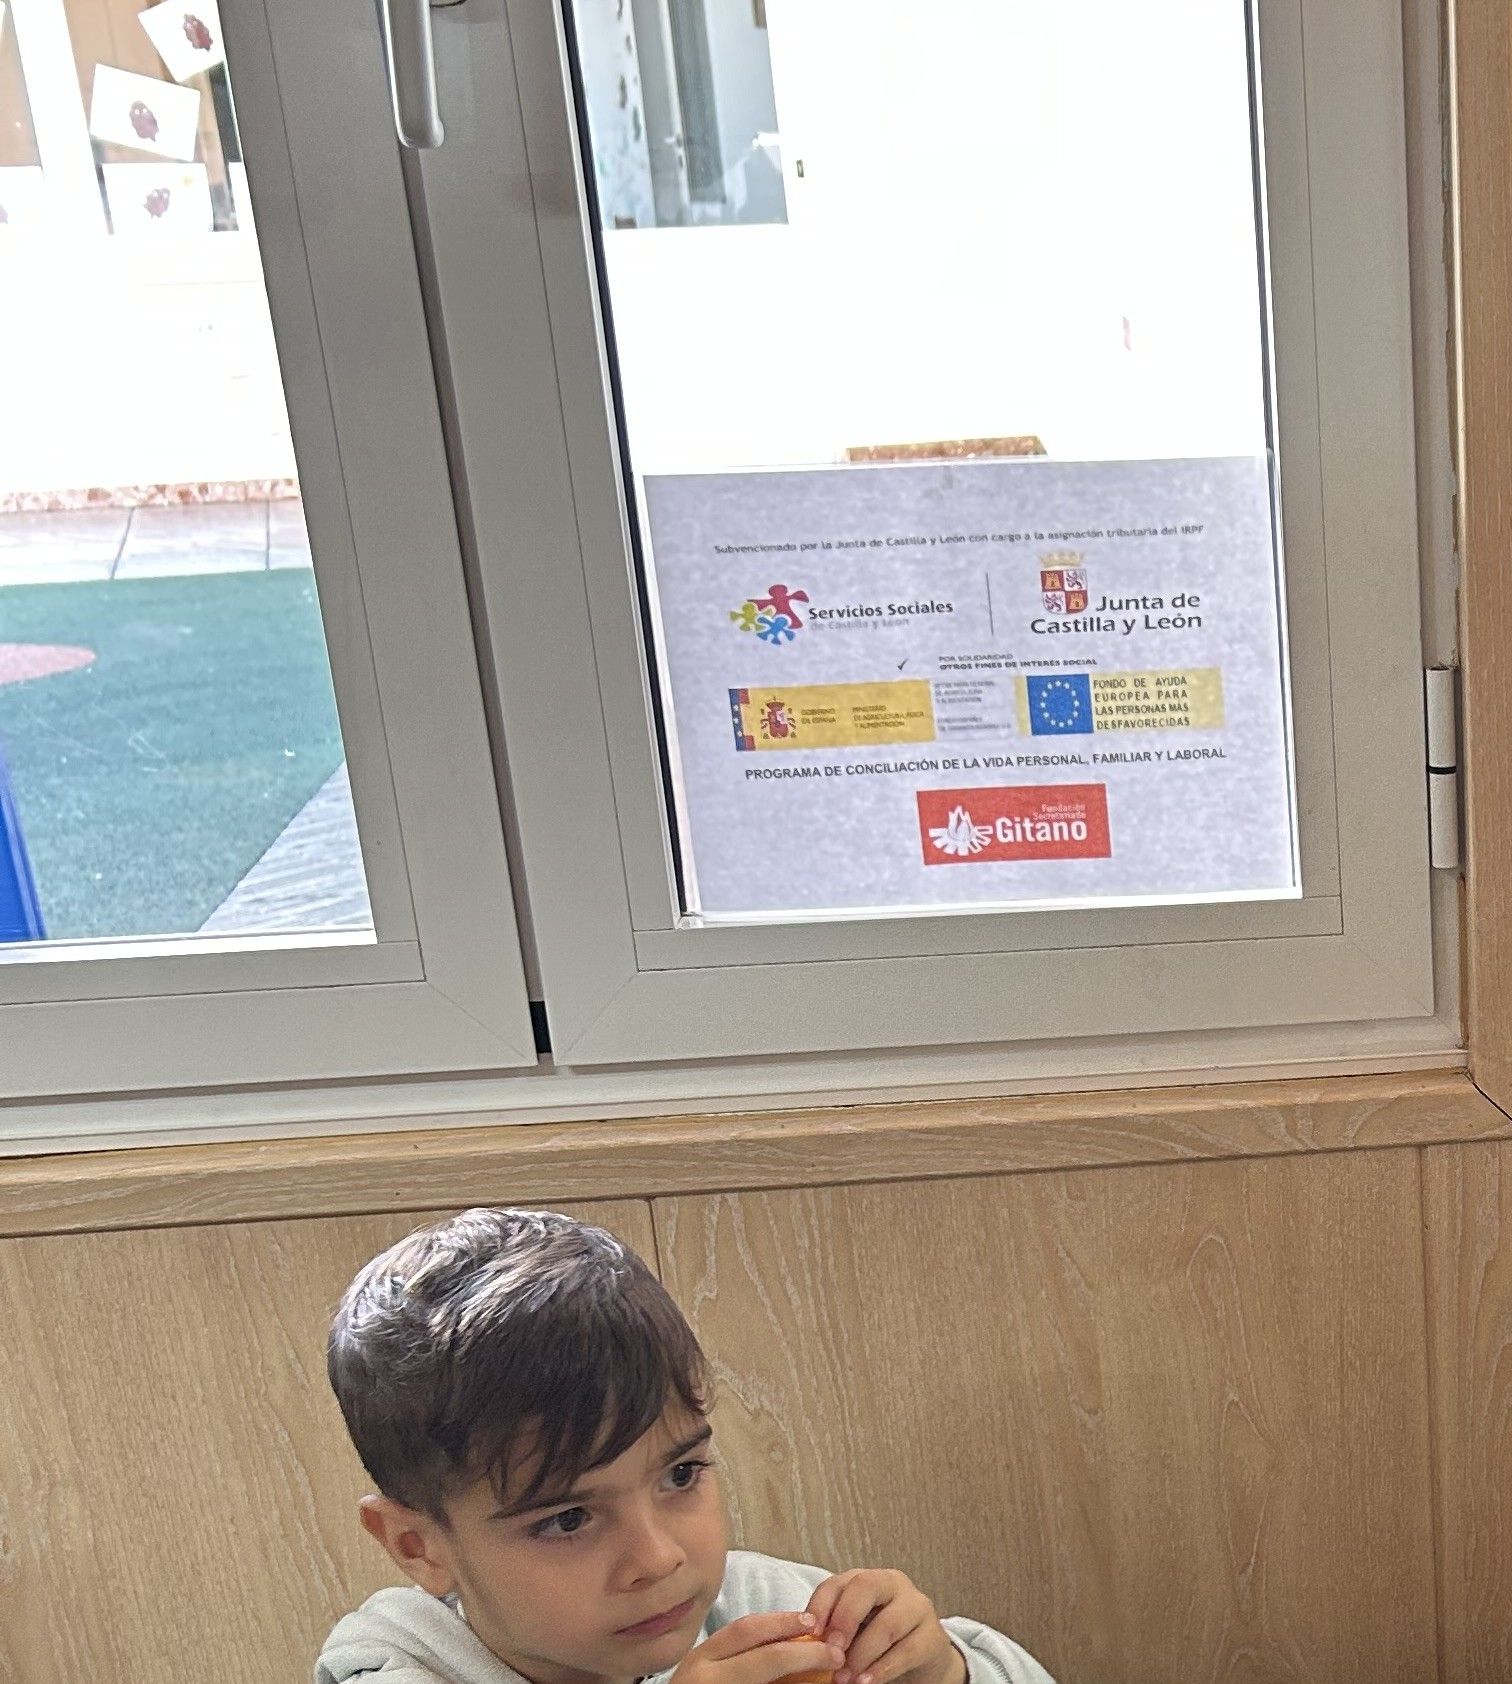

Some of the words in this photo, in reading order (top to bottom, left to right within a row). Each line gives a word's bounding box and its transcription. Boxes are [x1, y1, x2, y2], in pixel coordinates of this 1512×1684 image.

[714, 543, 797, 554] Subvencionado
[800, 542, 818, 552] por
[822, 541, 833, 550] la
[836, 540, 866, 550] Junta
[869, 538, 883, 547] de
[886, 536, 927, 547] Castilla
[930, 537, 937, 545] y
[969, 534, 988, 543] con
[991, 533, 1022, 543] cargo
[1024, 532, 1031, 541] a
[1034, 531, 1044, 541] la
[1048, 529, 1104, 541] asignación
[1107, 527, 1158, 538] tributaria
[1161, 525, 1178, 535] del
[1181, 524, 1204, 534] IRPF
[809, 605, 883, 620] Servicios
[888, 600, 954, 616] Sociales
[1095, 595, 1164, 612] Junta
[1171, 593, 1201, 608] de
[1030, 616, 1116, 634] Castilla
[1122, 618, 1136, 636] y
[1144, 613, 1202, 630] León
[1094, 678, 1127, 689] FONDO
[1134, 678, 1146, 688] DE
[1155, 676, 1187, 687] AYUDA
[1095, 691, 1150, 702] EUROPEA
[1158, 690, 1188, 699] PARA
[1095, 706, 1113, 715] LAS
[1116, 704, 1167, 714] PERSONAS
[1097, 717, 1190, 730] DESFAVORECIDAS
[745, 767, 820, 780] PROGRAMA
[824, 766, 842, 777] DE
[846, 758, 939, 775] CONCILIACIÓN
[942, 759, 960, 769] DE
[964, 757, 980, 769] LA
[983, 756, 1014, 768] VIDA
[1017, 754, 1089, 767] PERSONAL,
[1093, 751, 1152, 764] FAMILIAR
[1155, 750, 1164, 760] Y
[1167, 748, 1227, 760] LABORAL
[996, 816, 1088, 843] Gitano
